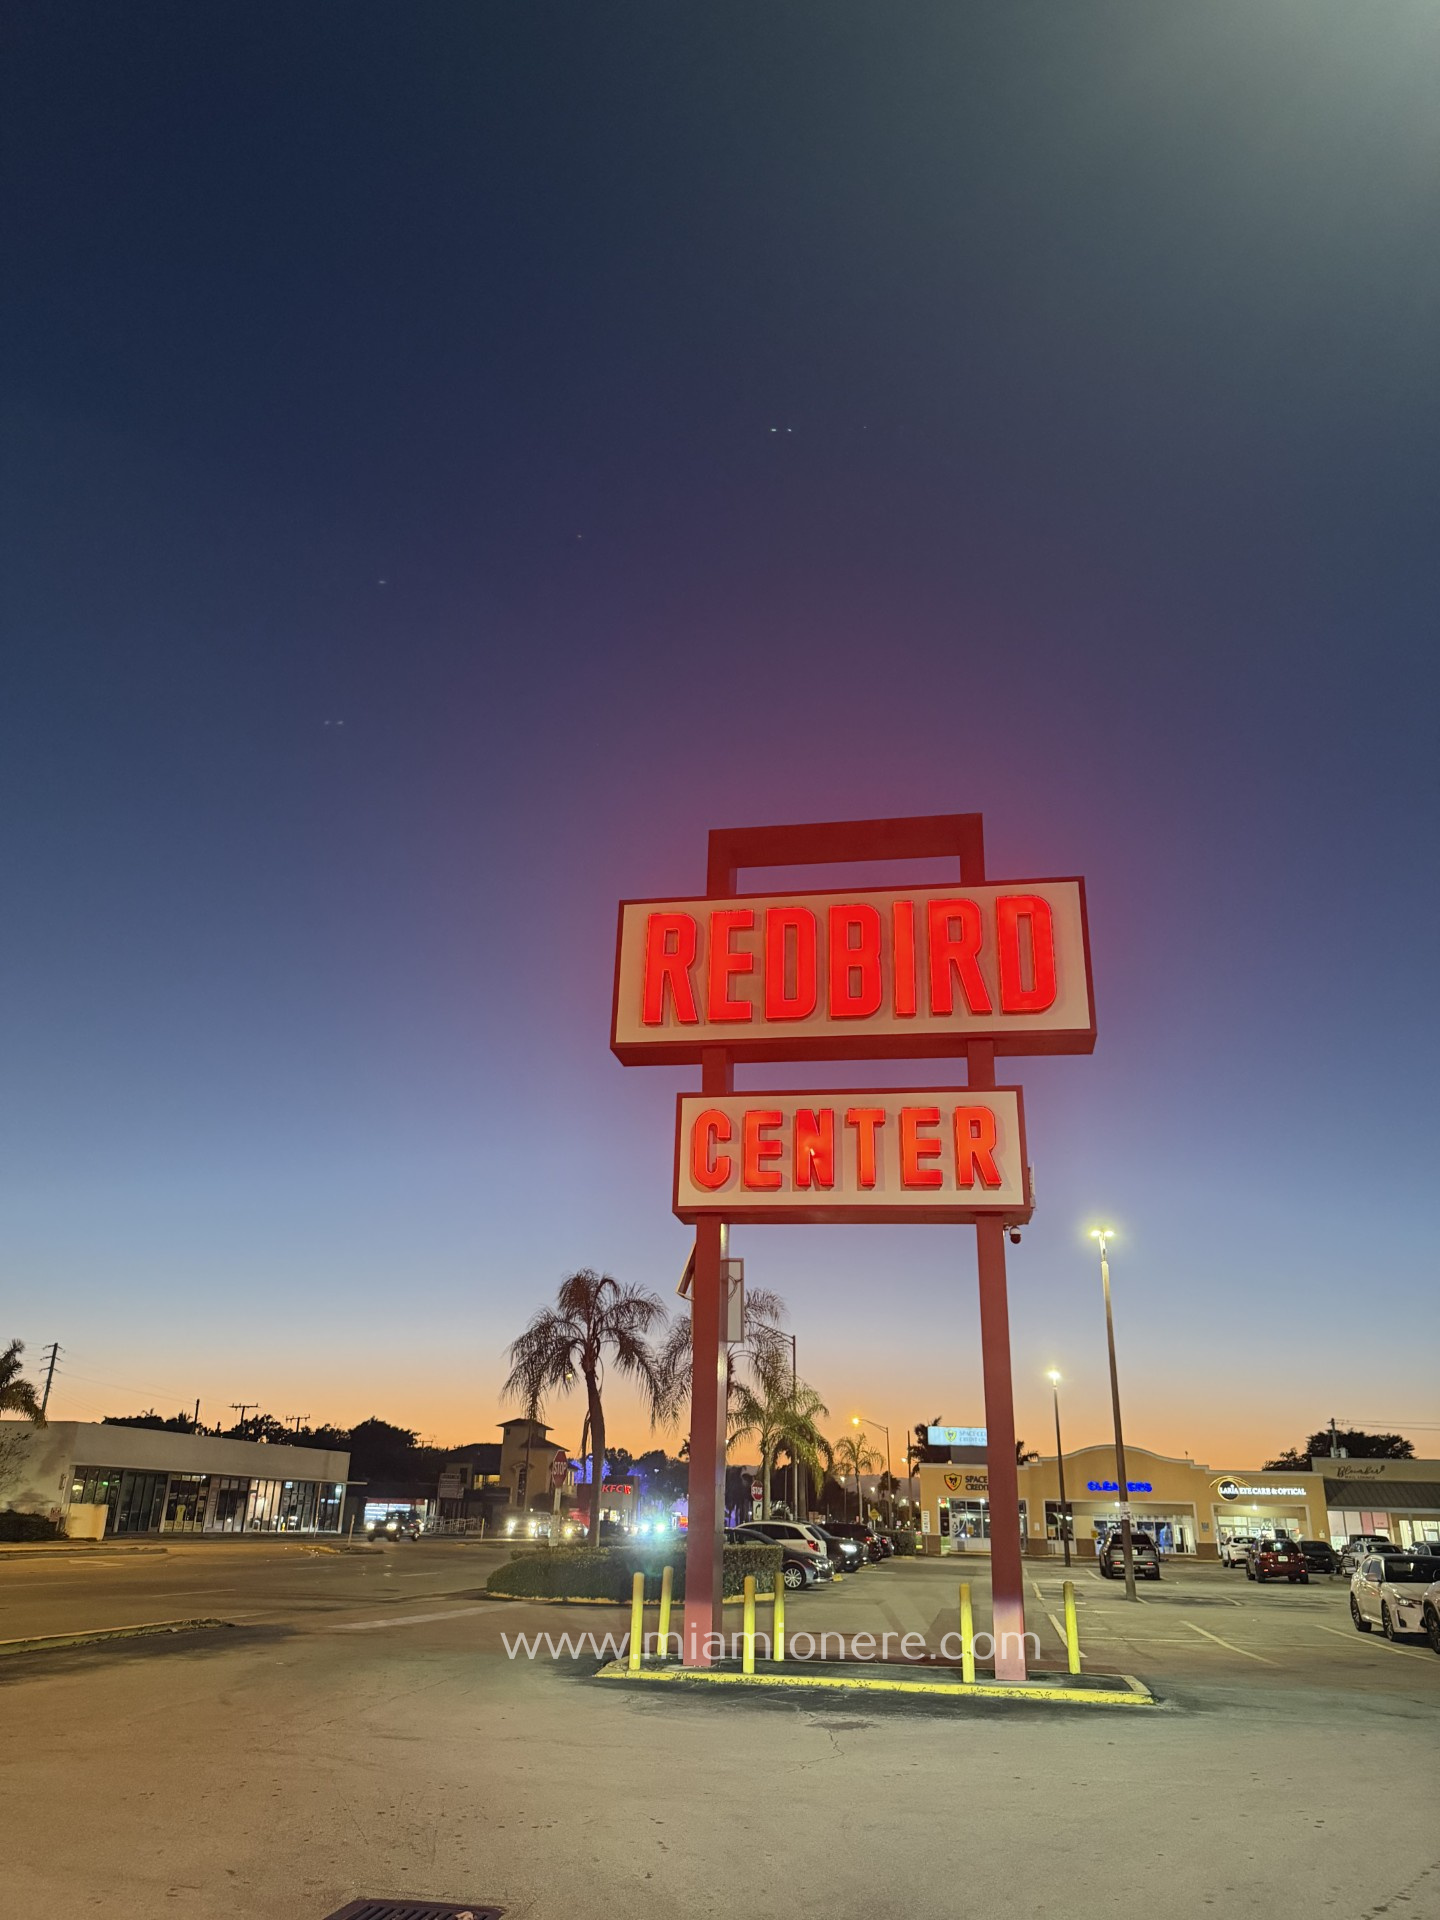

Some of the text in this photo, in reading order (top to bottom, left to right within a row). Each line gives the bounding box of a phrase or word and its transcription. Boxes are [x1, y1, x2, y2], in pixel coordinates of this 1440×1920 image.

[642, 895, 1057, 1025] REDBIRD
[693, 1106, 1002, 1188] CENTER
[553, 1461, 567, 1476] STOP
[965, 1475, 988, 1484] SPACE
[602, 1484, 623, 1493] KFC
[752, 1486, 763, 1495] STOP
[965, 1483, 989, 1491] CREDIT
[1087, 1480, 1152, 1492] CLEAERS
[1239, 1487, 1252, 1495] EYE
[1252, 1487, 1271, 1495] CARE
[1278, 1487, 1307, 1496] OPTICAL
